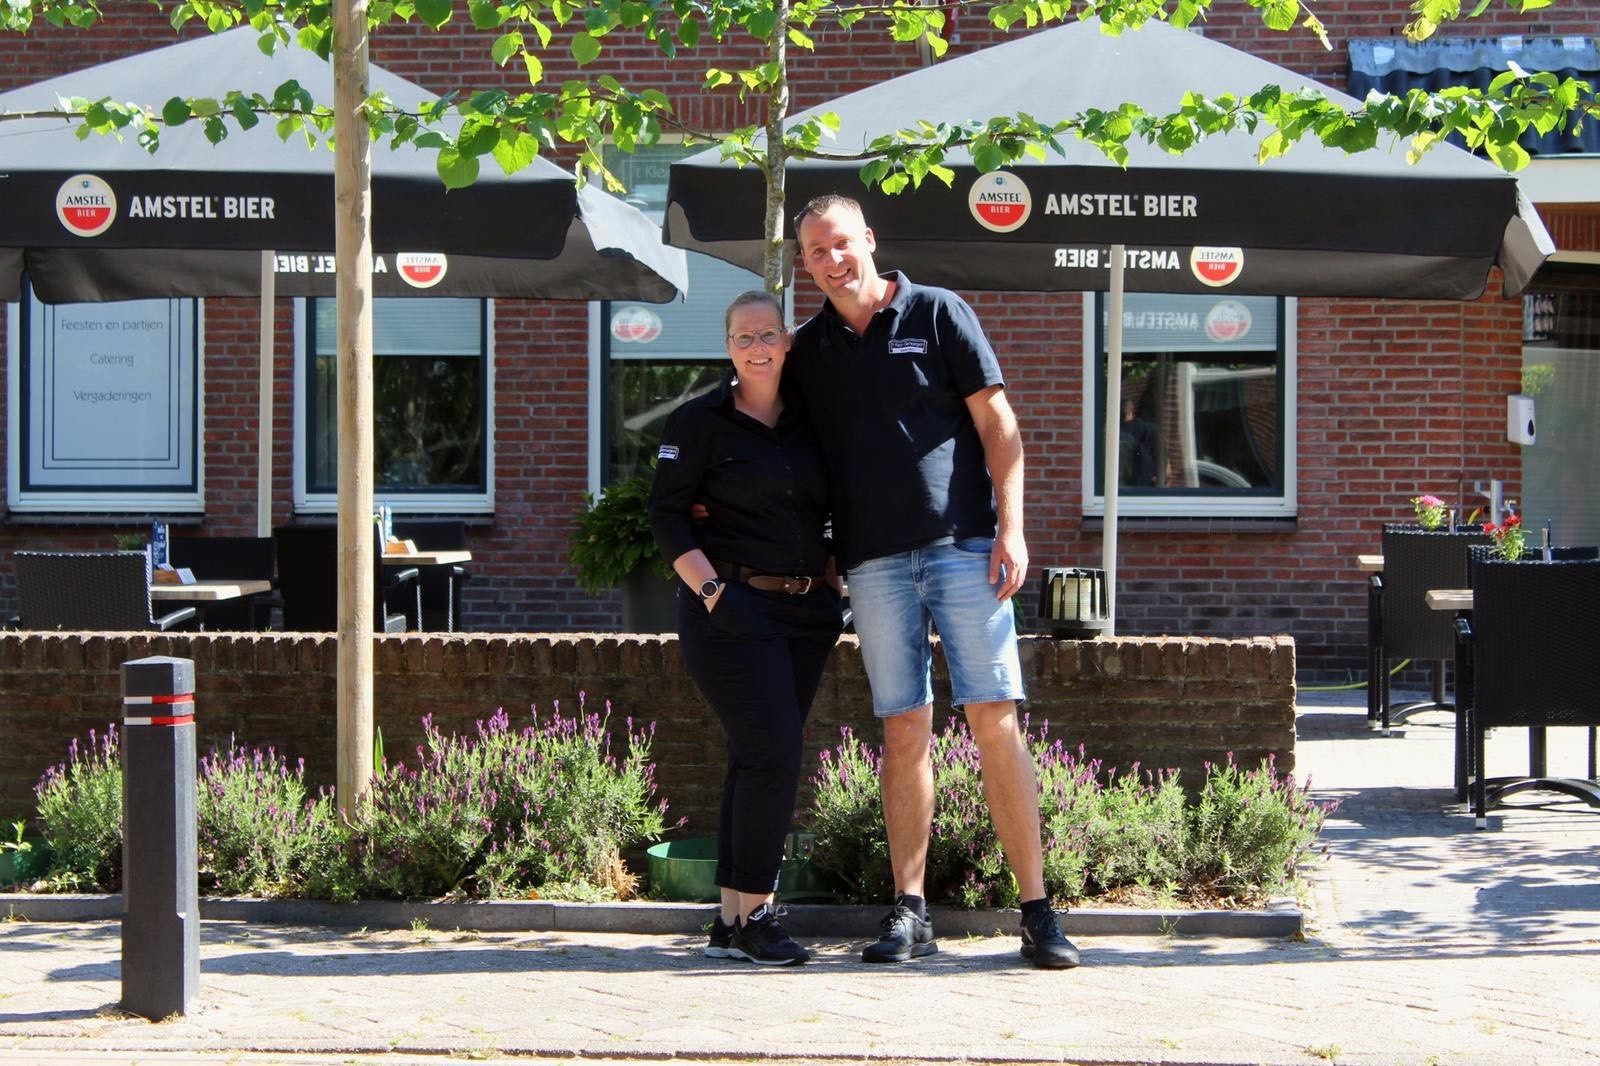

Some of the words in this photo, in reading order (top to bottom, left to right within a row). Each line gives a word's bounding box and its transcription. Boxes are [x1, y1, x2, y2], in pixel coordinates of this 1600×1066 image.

[66, 195, 107, 205] AMSTEL
[979, 192, 1021, 203] AMSTEL
[77, 208, 96, 217] BIER
[224, 196, 275, 219] BIER
[990, 205, 1011, 214] BIER
[1144, 195, 1197, 217] BIER
[61, 319, 102, 331] Feesten
[105, 321, 120, 331] en
[122, 319, 164, 332] partijen
[89, 352, 134, 367] Catering
[73, 390, 152, 404] Vergaderingen
